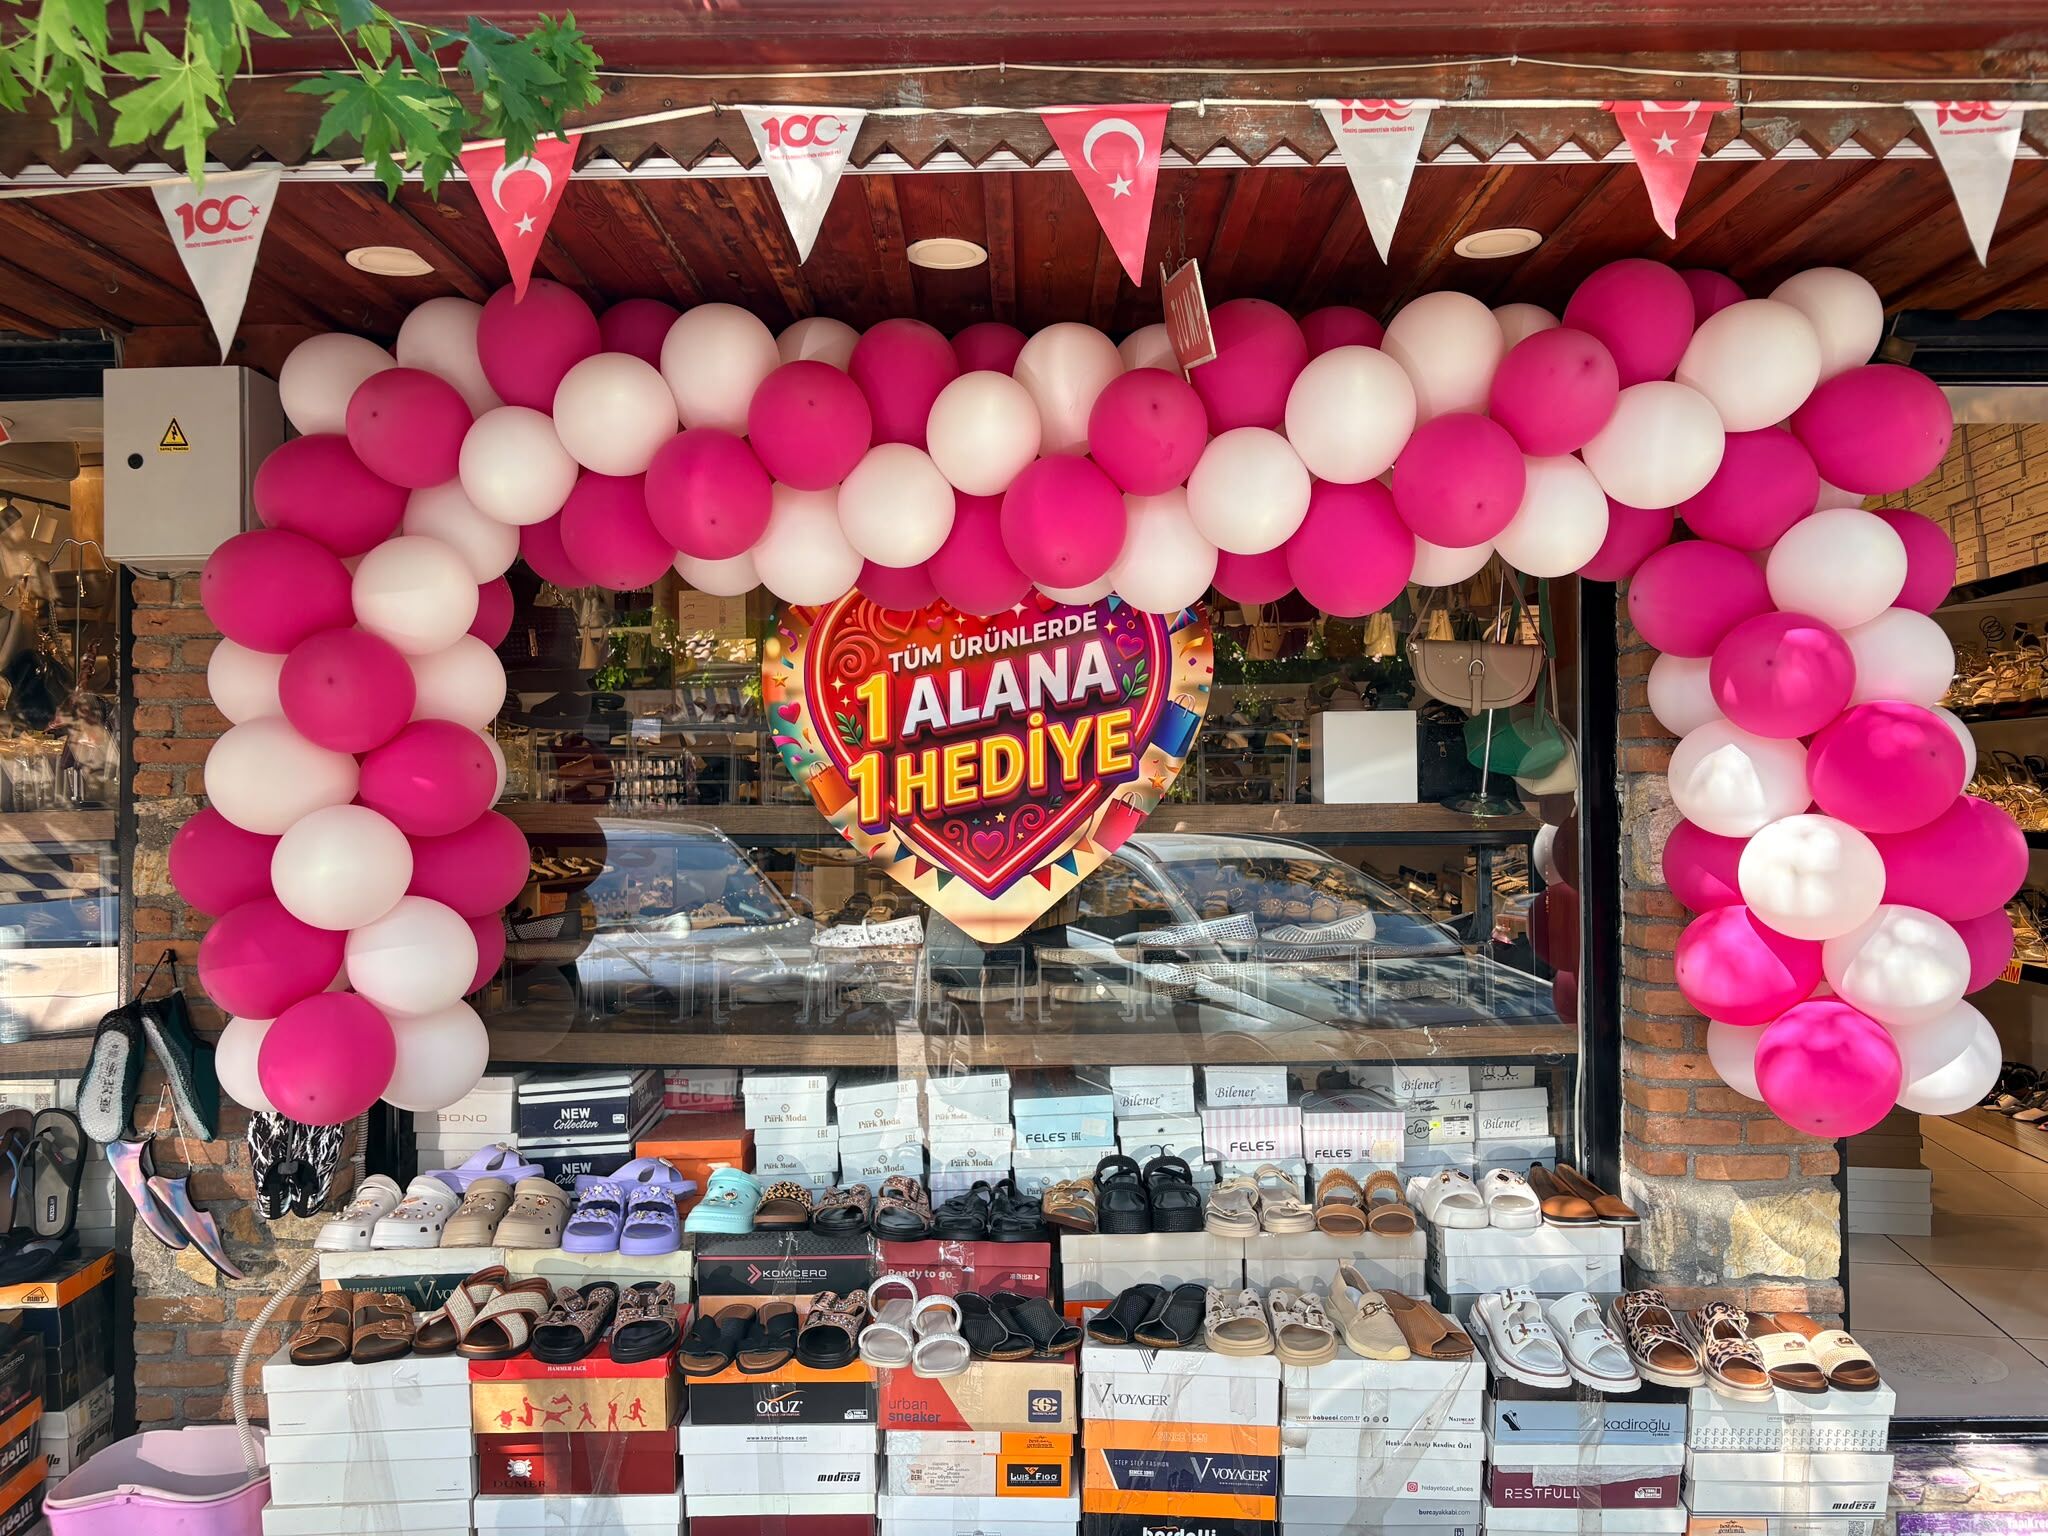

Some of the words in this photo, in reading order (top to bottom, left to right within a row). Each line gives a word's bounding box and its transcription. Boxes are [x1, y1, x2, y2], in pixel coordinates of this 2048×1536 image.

[888, 643, 942, 673] TÜM
[950, 610, 1097, 660] ÜRÜNLERDE
[856, 673, 889, 744] 1
[902, 640, 1117, 737] ALANA
[848, 751, 882, 825] 1
[896, 708, 1133, 816] HEDİYE
[1215, 1086, 1256, 1098] Bilener
[1120, 1095, 1160, 1107] Bilener
[437, 1113, 488, 1122] BONO
[561, 1108, 590, 1119] NEW
[553, 1118, 599, 1130] Collection
[1483, 1117, 1520, 1130] Bilener
[1026, 1133, 1066, 1143] FELES
[1230, 1141, 1275, 1152] FELES
[1315, 1149, 1352, 1158] FELES
[562, 1163, 592, 1174] NEW
[554, 1174, 576, 1185] Colle
[763, 1269, 827, 1277] KOMCERO
[888, 1269, 923, 1279] Ready
[925, 1269, 936, 1277] to
[888, 1398, 928, 1410] urban
[1112, 1394, 1168, 1406] VOYAGER
[888, 1411, 941, 1423] sneaker
[1604, 1418, 1671, 1434] kadiroğlu
[1146, 1460, 1170, 1468] FASHION
[817, 1471, 860, 1482] modesa
[1212, 1468, 1268, 1482] VOYAGER
[493, 1480, 545, 1488] DUMER
[1504, 1488, 1580, 1499] RESTFULL
[1832, 1500, 1876, 1509] modesa
